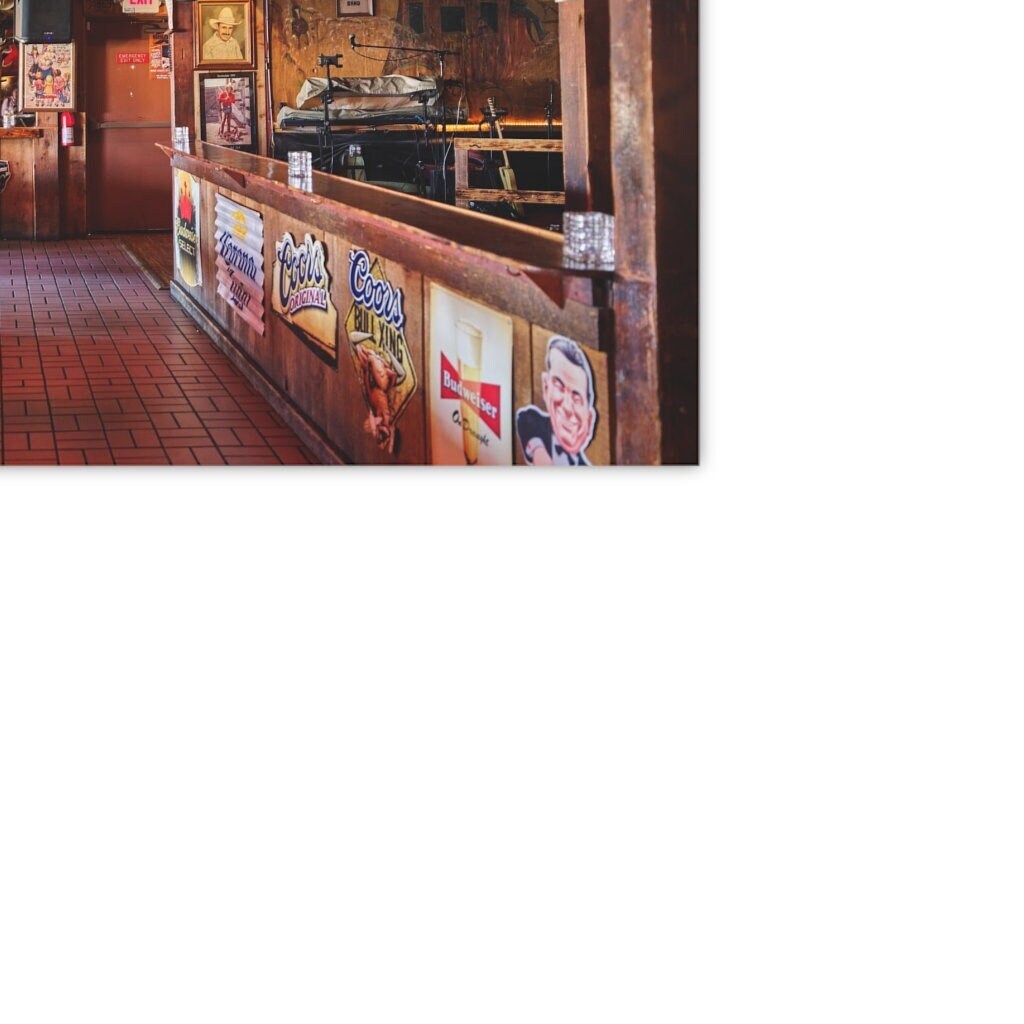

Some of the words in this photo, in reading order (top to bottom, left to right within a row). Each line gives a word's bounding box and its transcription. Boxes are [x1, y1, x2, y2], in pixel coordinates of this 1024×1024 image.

[179, 238, 195, 256] SELECT
[219, 231, 257, 282] Corona
[277, 237, 323, 308] Coors
[349, 250, 404, 330] Coors
[290, 287, 326, 311] ORIGINAL
[379, 319, 404, 363] XING
[443, 369, 498, 419] Budweiser
